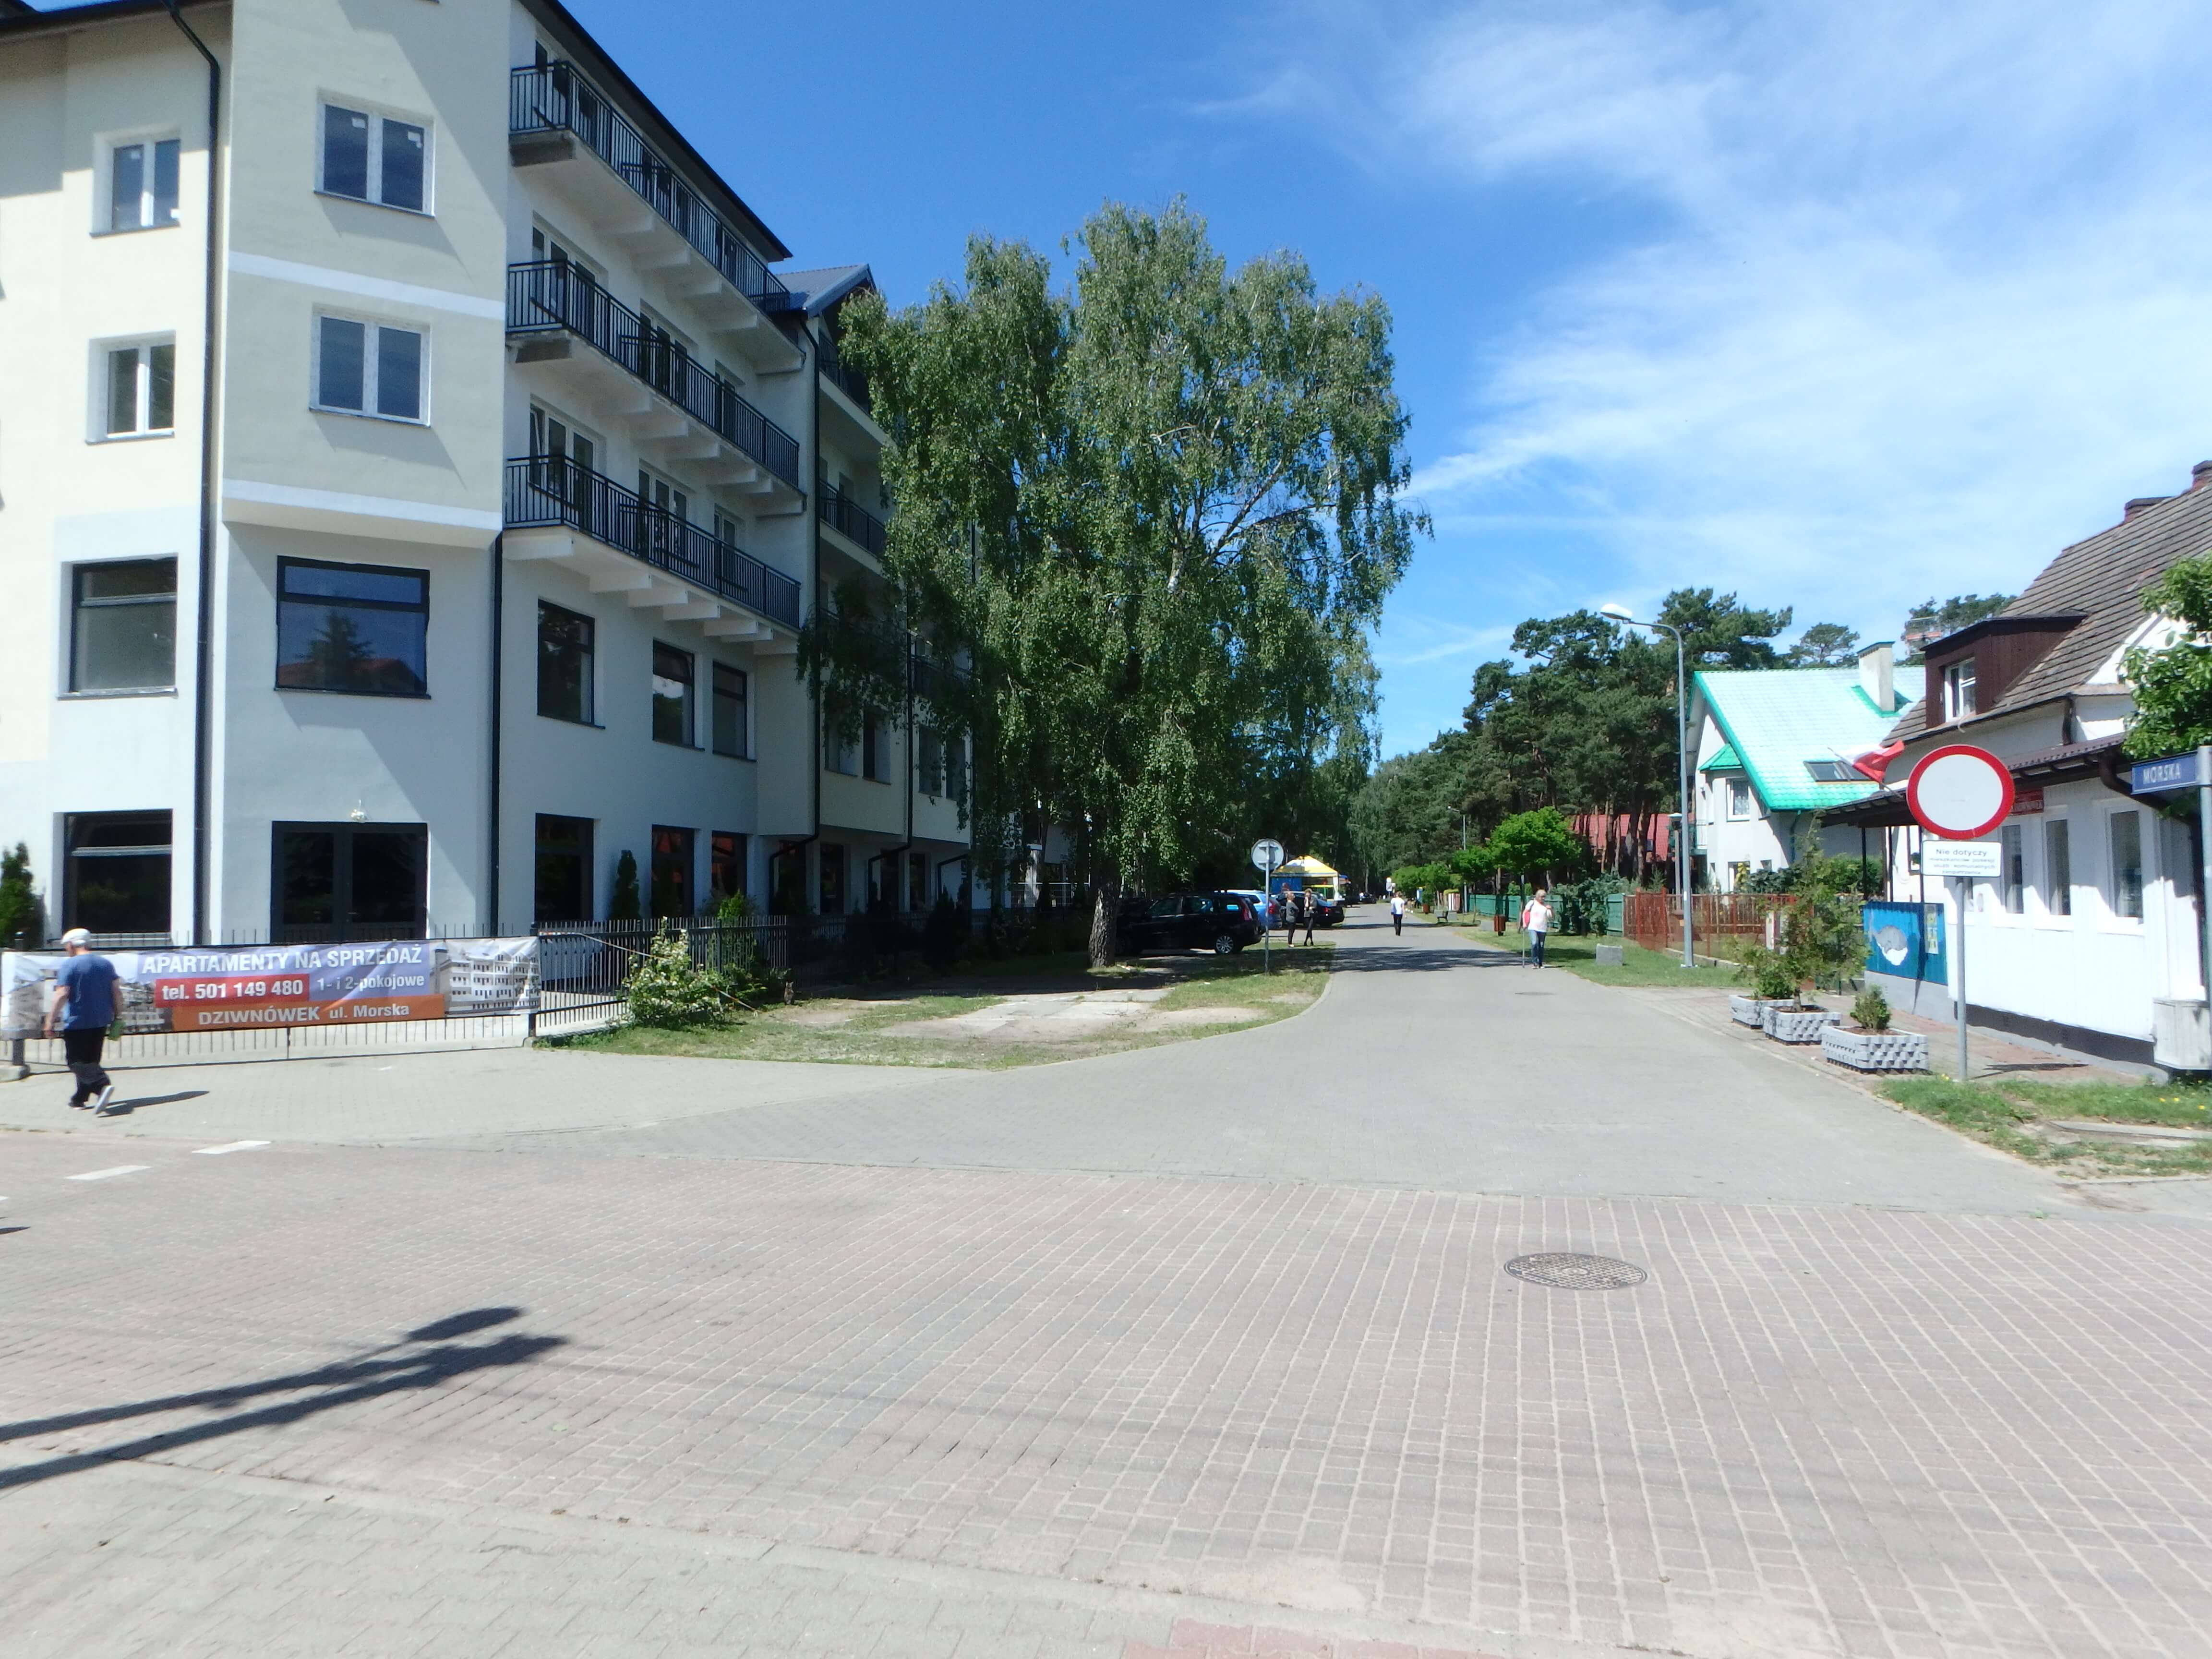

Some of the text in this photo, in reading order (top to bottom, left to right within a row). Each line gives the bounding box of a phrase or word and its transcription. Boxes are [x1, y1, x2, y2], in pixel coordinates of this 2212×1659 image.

[2143, 763, 2181, 784] MORSKA
[142, 943, 422, 974] APARTAMENTY NA SPRZEDAŻ
[162, 980, 303, 1000] tel. 501 149 480
[336, 977, 341, 990] i
[345, 974, 424, 991] 2-pokojowe
[199, 1004, 409, 1025] DZIWNÓWEK ul. Morska
